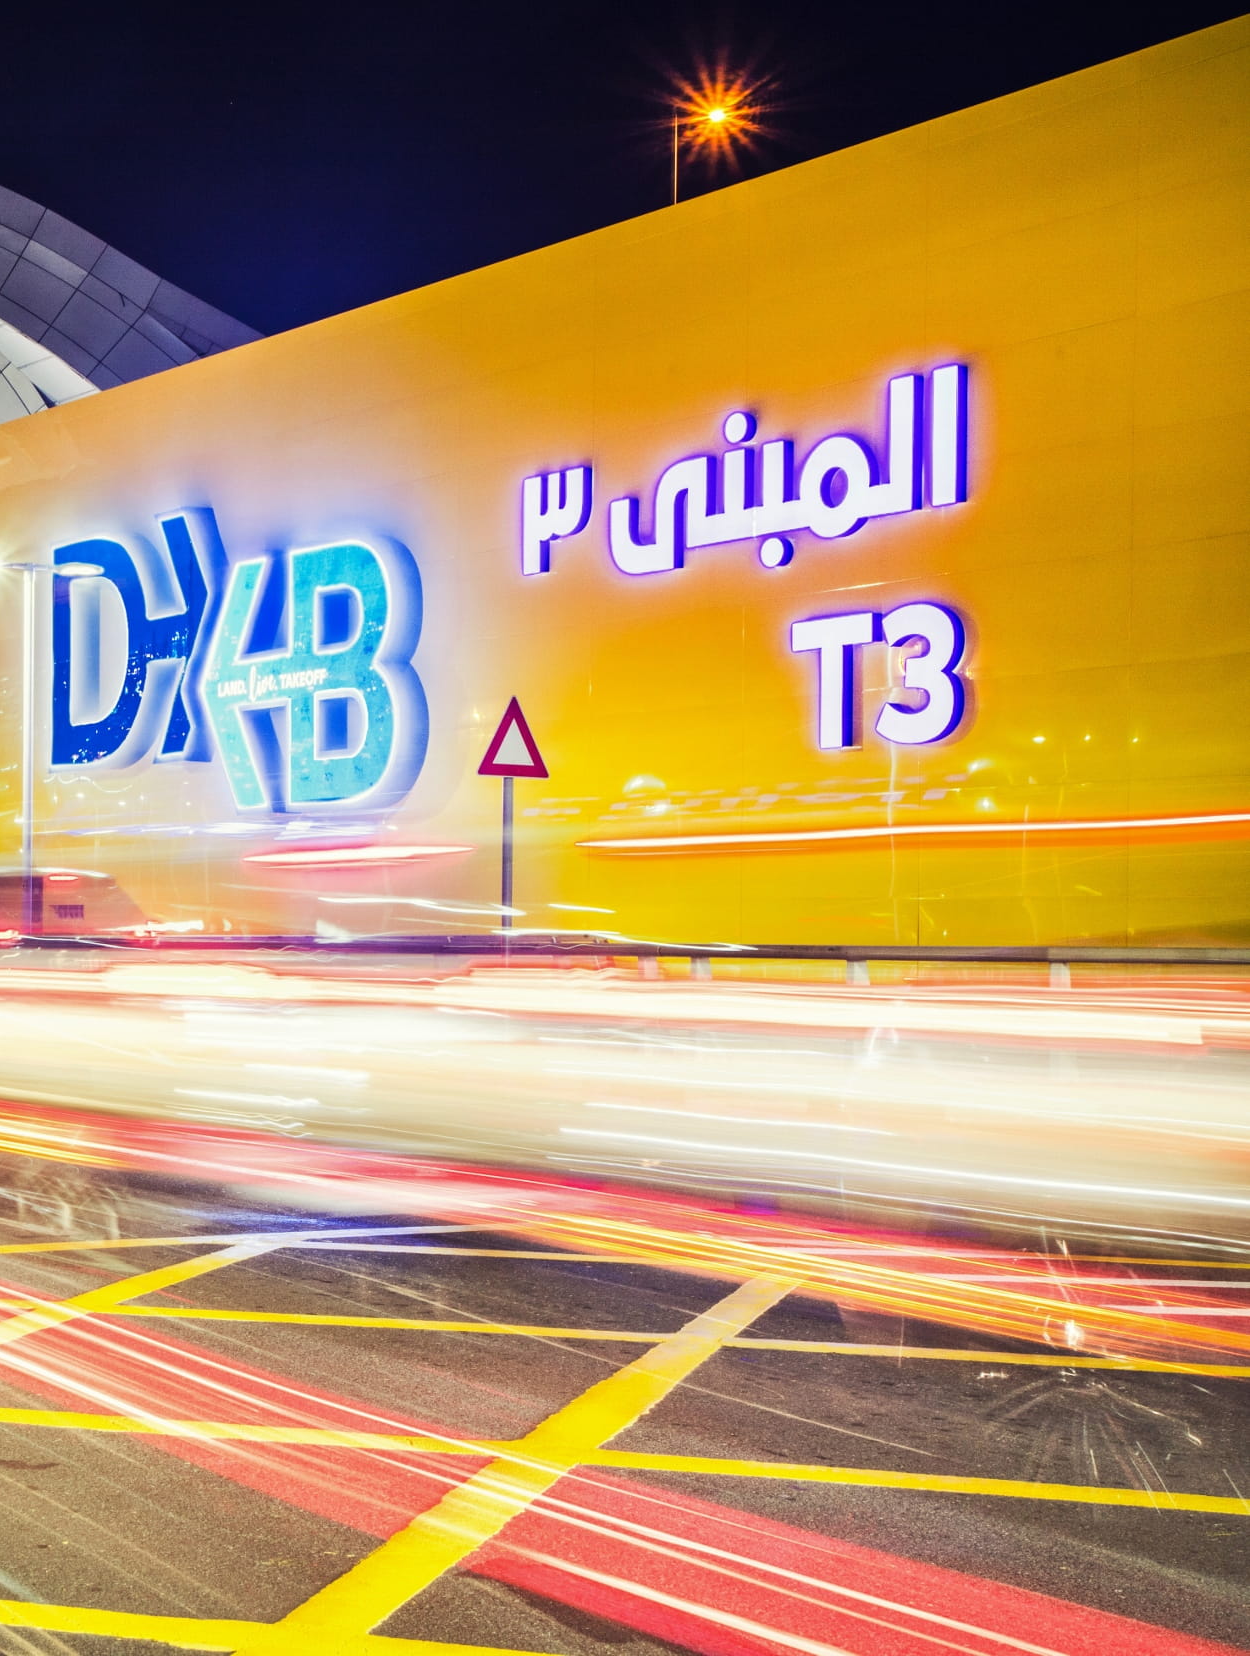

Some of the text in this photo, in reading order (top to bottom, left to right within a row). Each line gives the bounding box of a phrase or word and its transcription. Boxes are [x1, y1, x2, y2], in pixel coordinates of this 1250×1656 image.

[49, 507, 428, 813] DXB
[280, 668, 327, 689] TAKEOFF
[790, 601, 966, 750] T3
